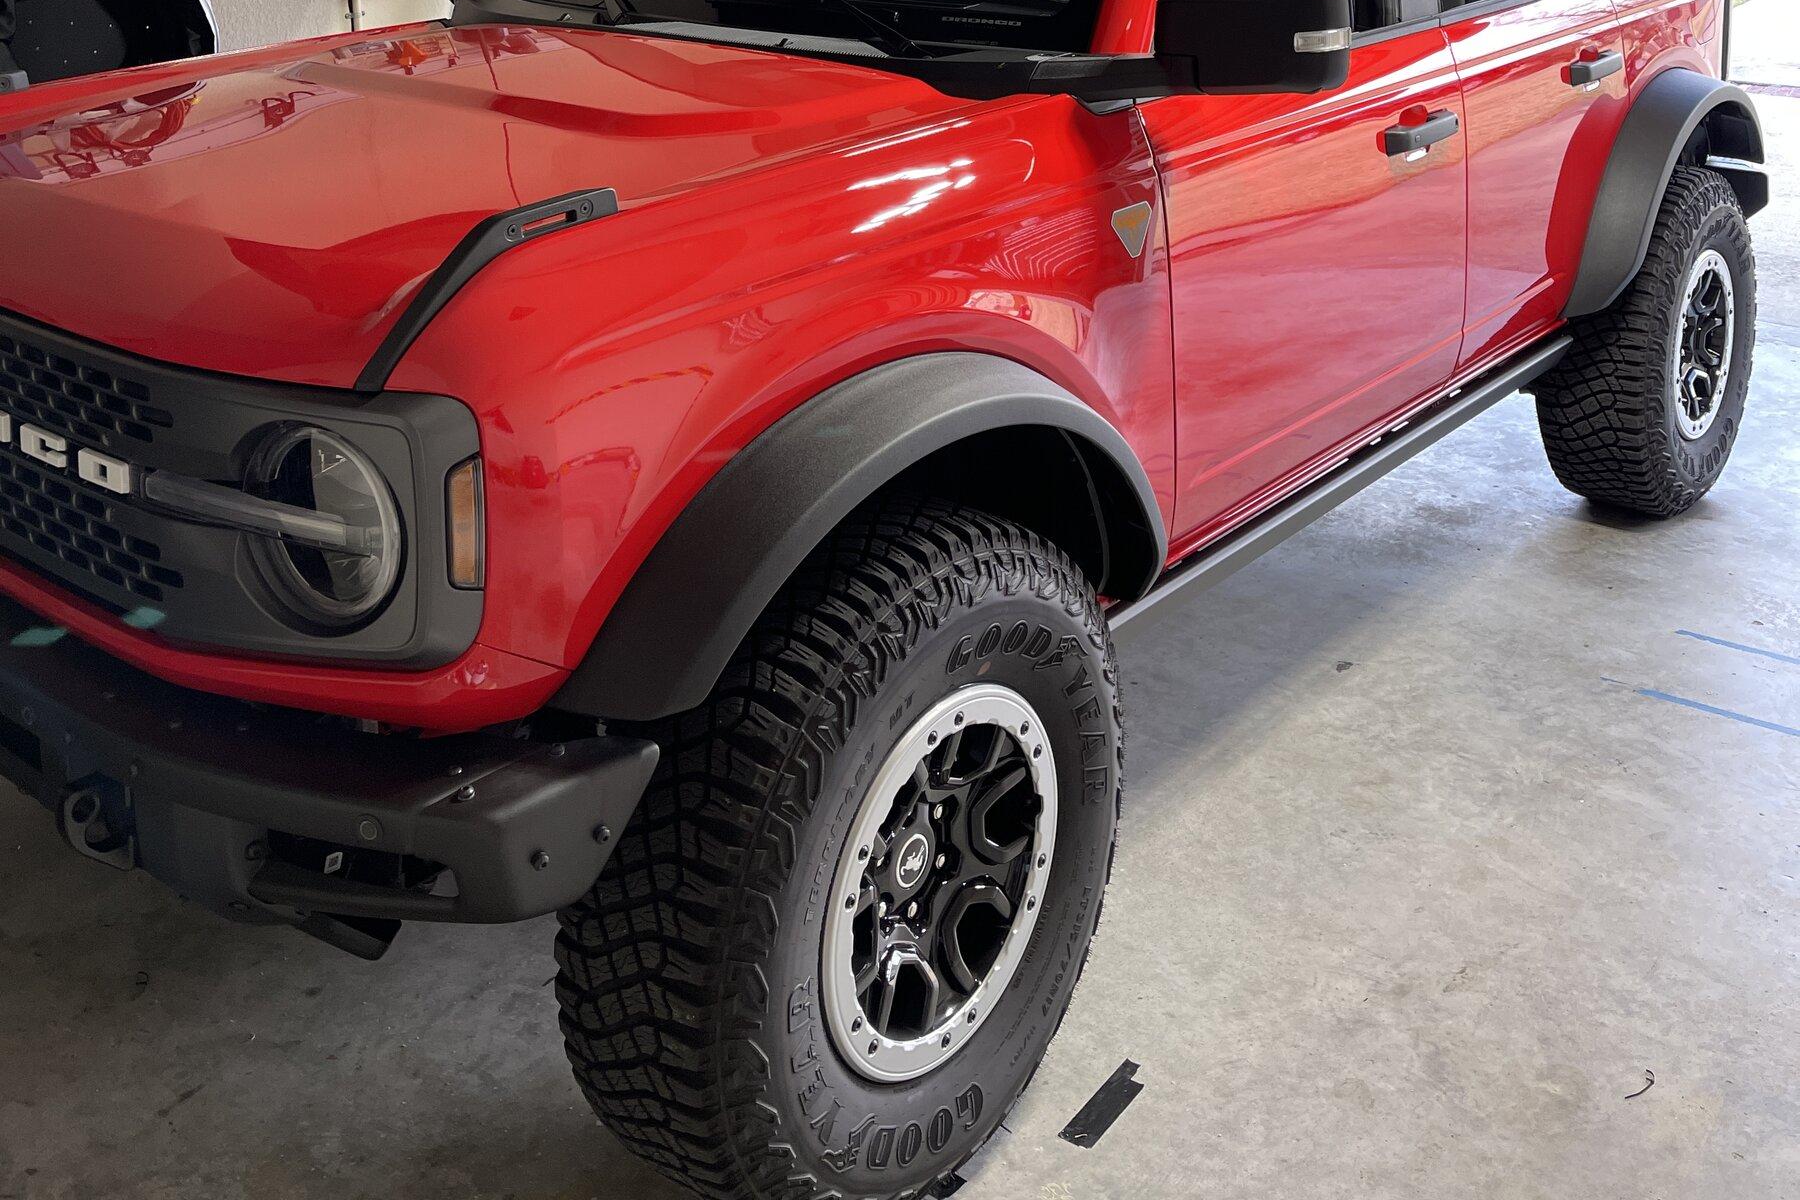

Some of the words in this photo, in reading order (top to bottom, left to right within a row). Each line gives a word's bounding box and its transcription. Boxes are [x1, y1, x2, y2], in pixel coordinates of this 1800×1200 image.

[942, 16, 1021, 26] BRONCO
[0, 410, 130, 494] CO
[946, 620, 1109, 806] GOODYEAR
[788, 975, 984, 1174] GOODYEAR
